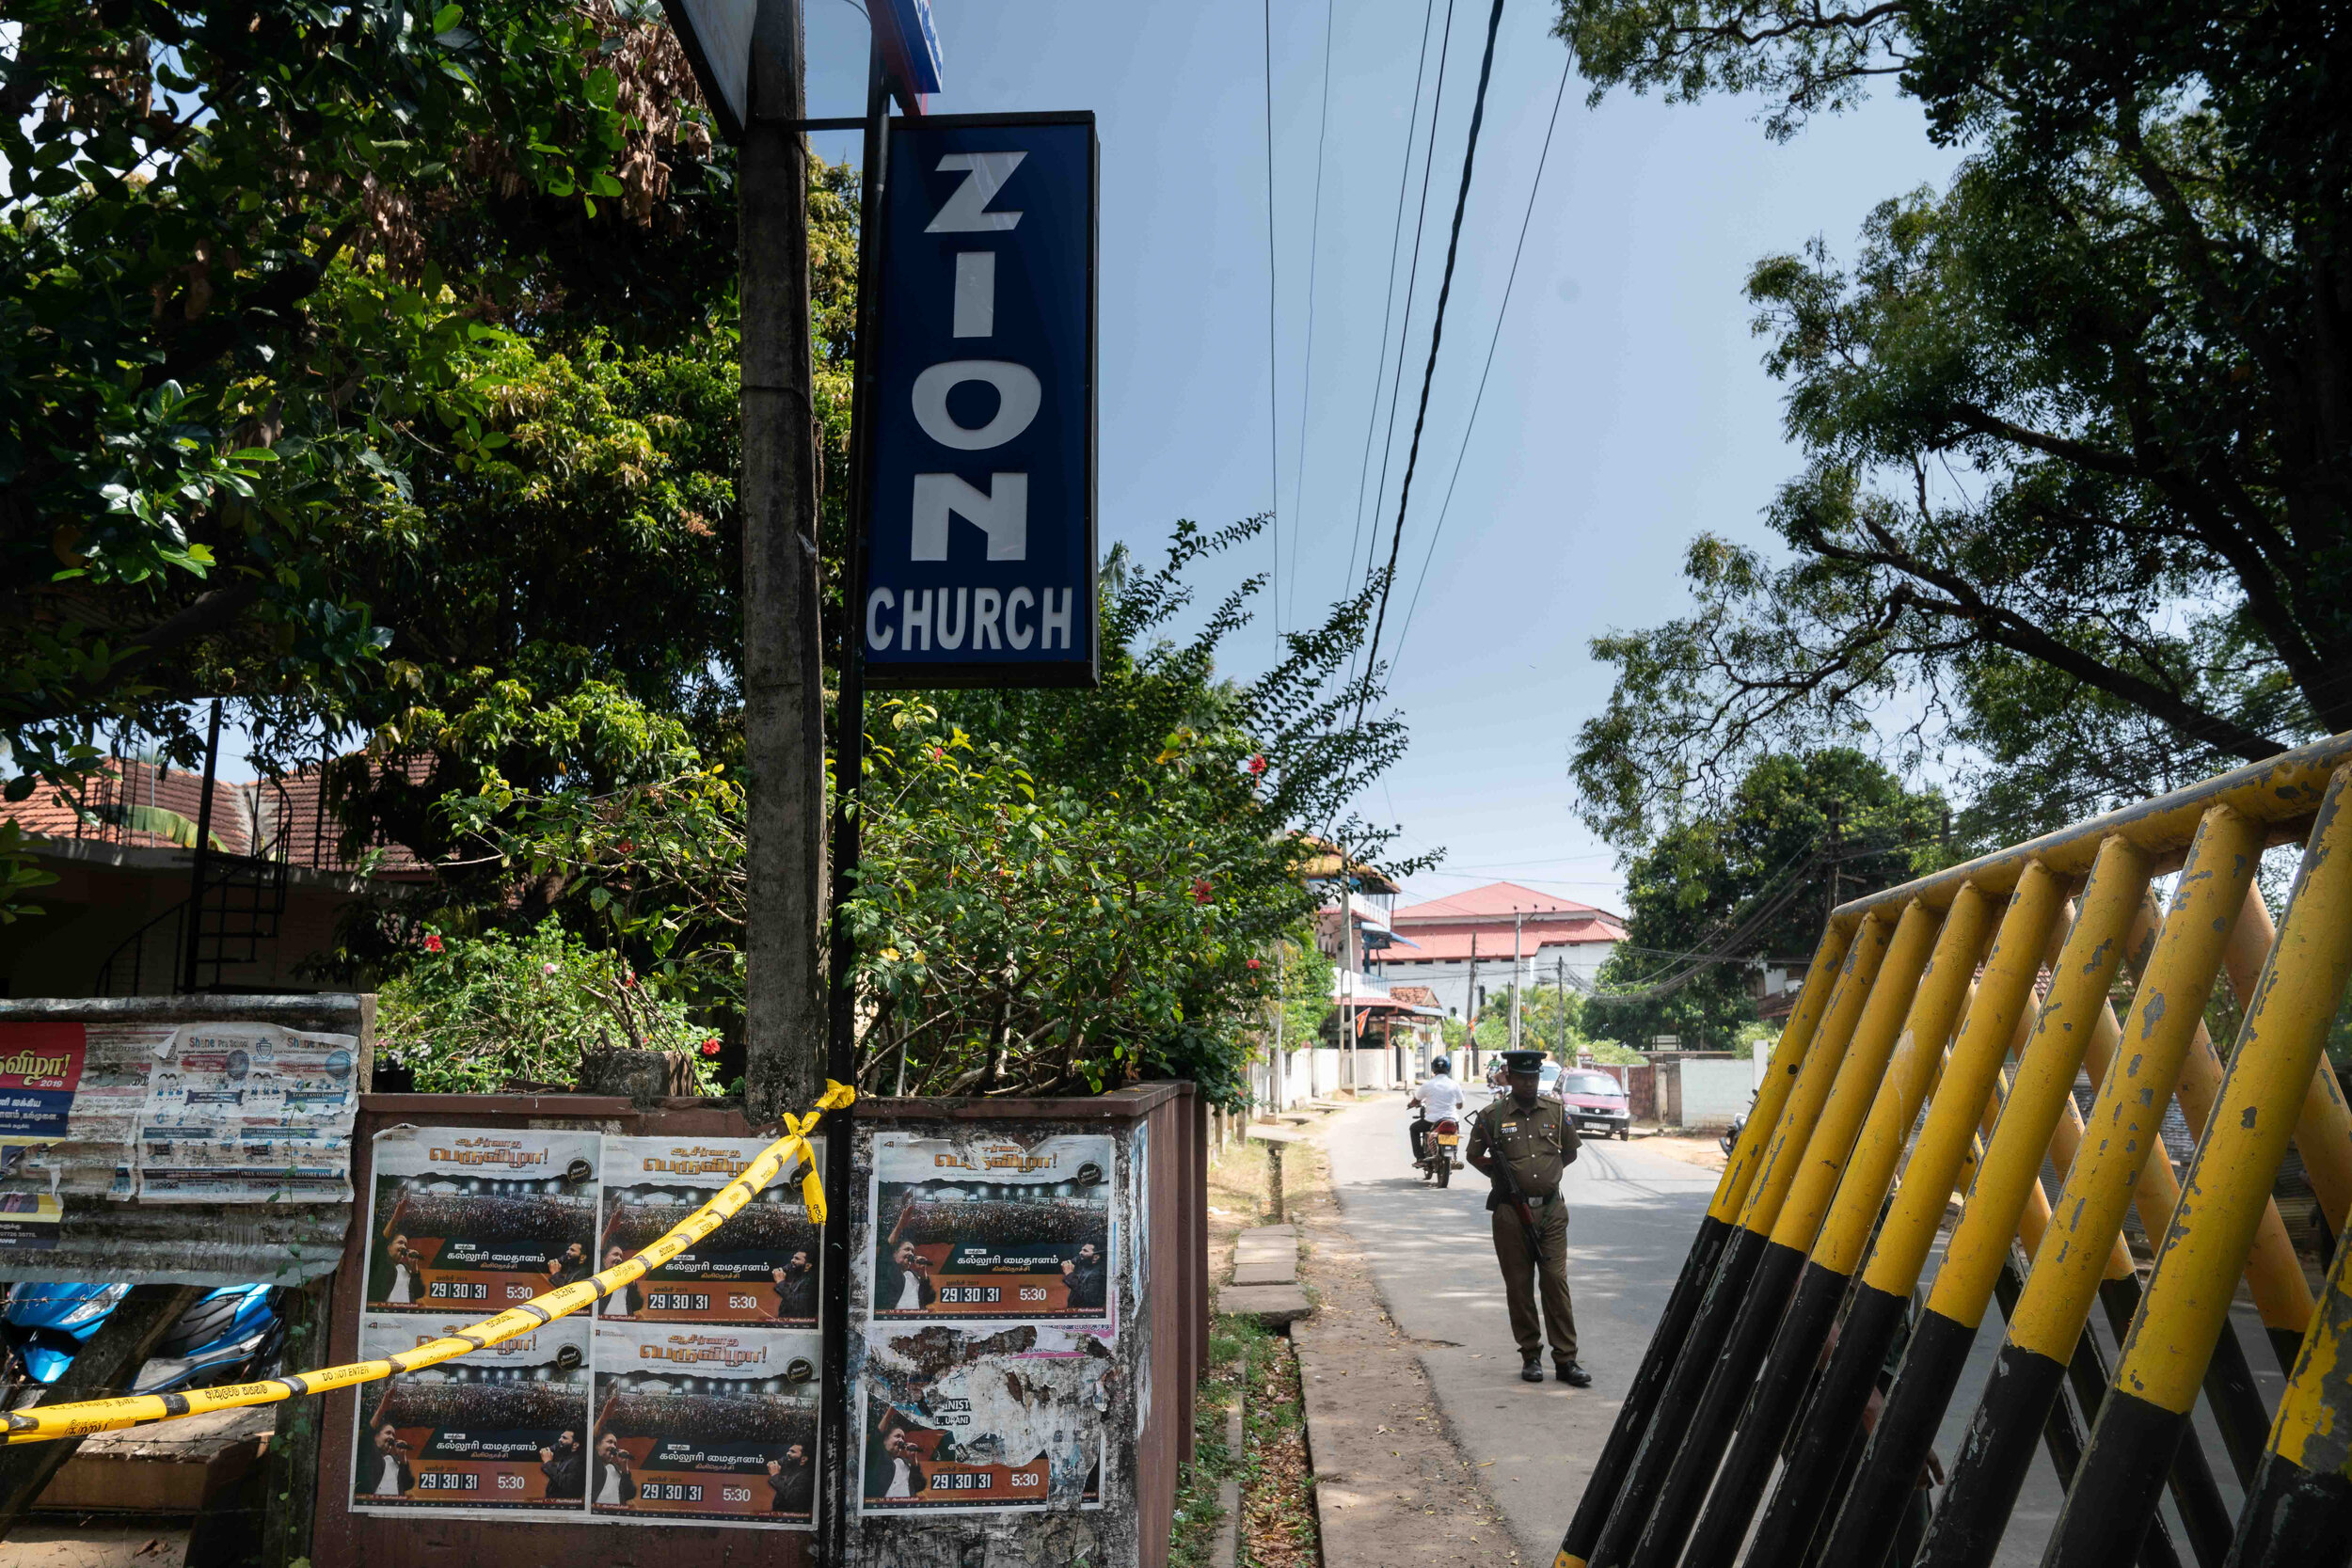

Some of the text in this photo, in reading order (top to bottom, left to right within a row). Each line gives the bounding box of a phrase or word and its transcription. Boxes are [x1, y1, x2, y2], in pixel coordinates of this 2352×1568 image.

[912, 150, 1041, 562] ZION
[866, 585, 1073, 651] CHURCH
[429, 1148, 548, 1168] பெருவிழா!
[447, 1250, 546, 1263] கல்லூரி மைதானம்
[957, 1255, 1058, 1266] கல்லூரி மைதானம்
[665, 1260, 770, 1273] கல்லூரி மைதானம்
[432, 1283, 533, 1299] 29 30 31 5:30
[942, 1288, 1047, 1303] 29 30 31 5:30
[650, 1294, 757, 1309] 29 30 31 5:30
[640, 1345, 767, 1367] பெருவிழா!
[322, 1371, 333, 1382] DO
[348, 1366, 370, 1377] ENTER
[437, 1440, 537, 1452] கல்லூரி மைதானம்
[660, 1450, 765, 1464] கல்லூரி மைதானம்
[421, 1474, 525, 1489] 29 30 31 5:30
[932, 1473, 1039, 1490] 29 30 31 5:30
[643, 1484, 751, 1501] 29 30 31 5:30
